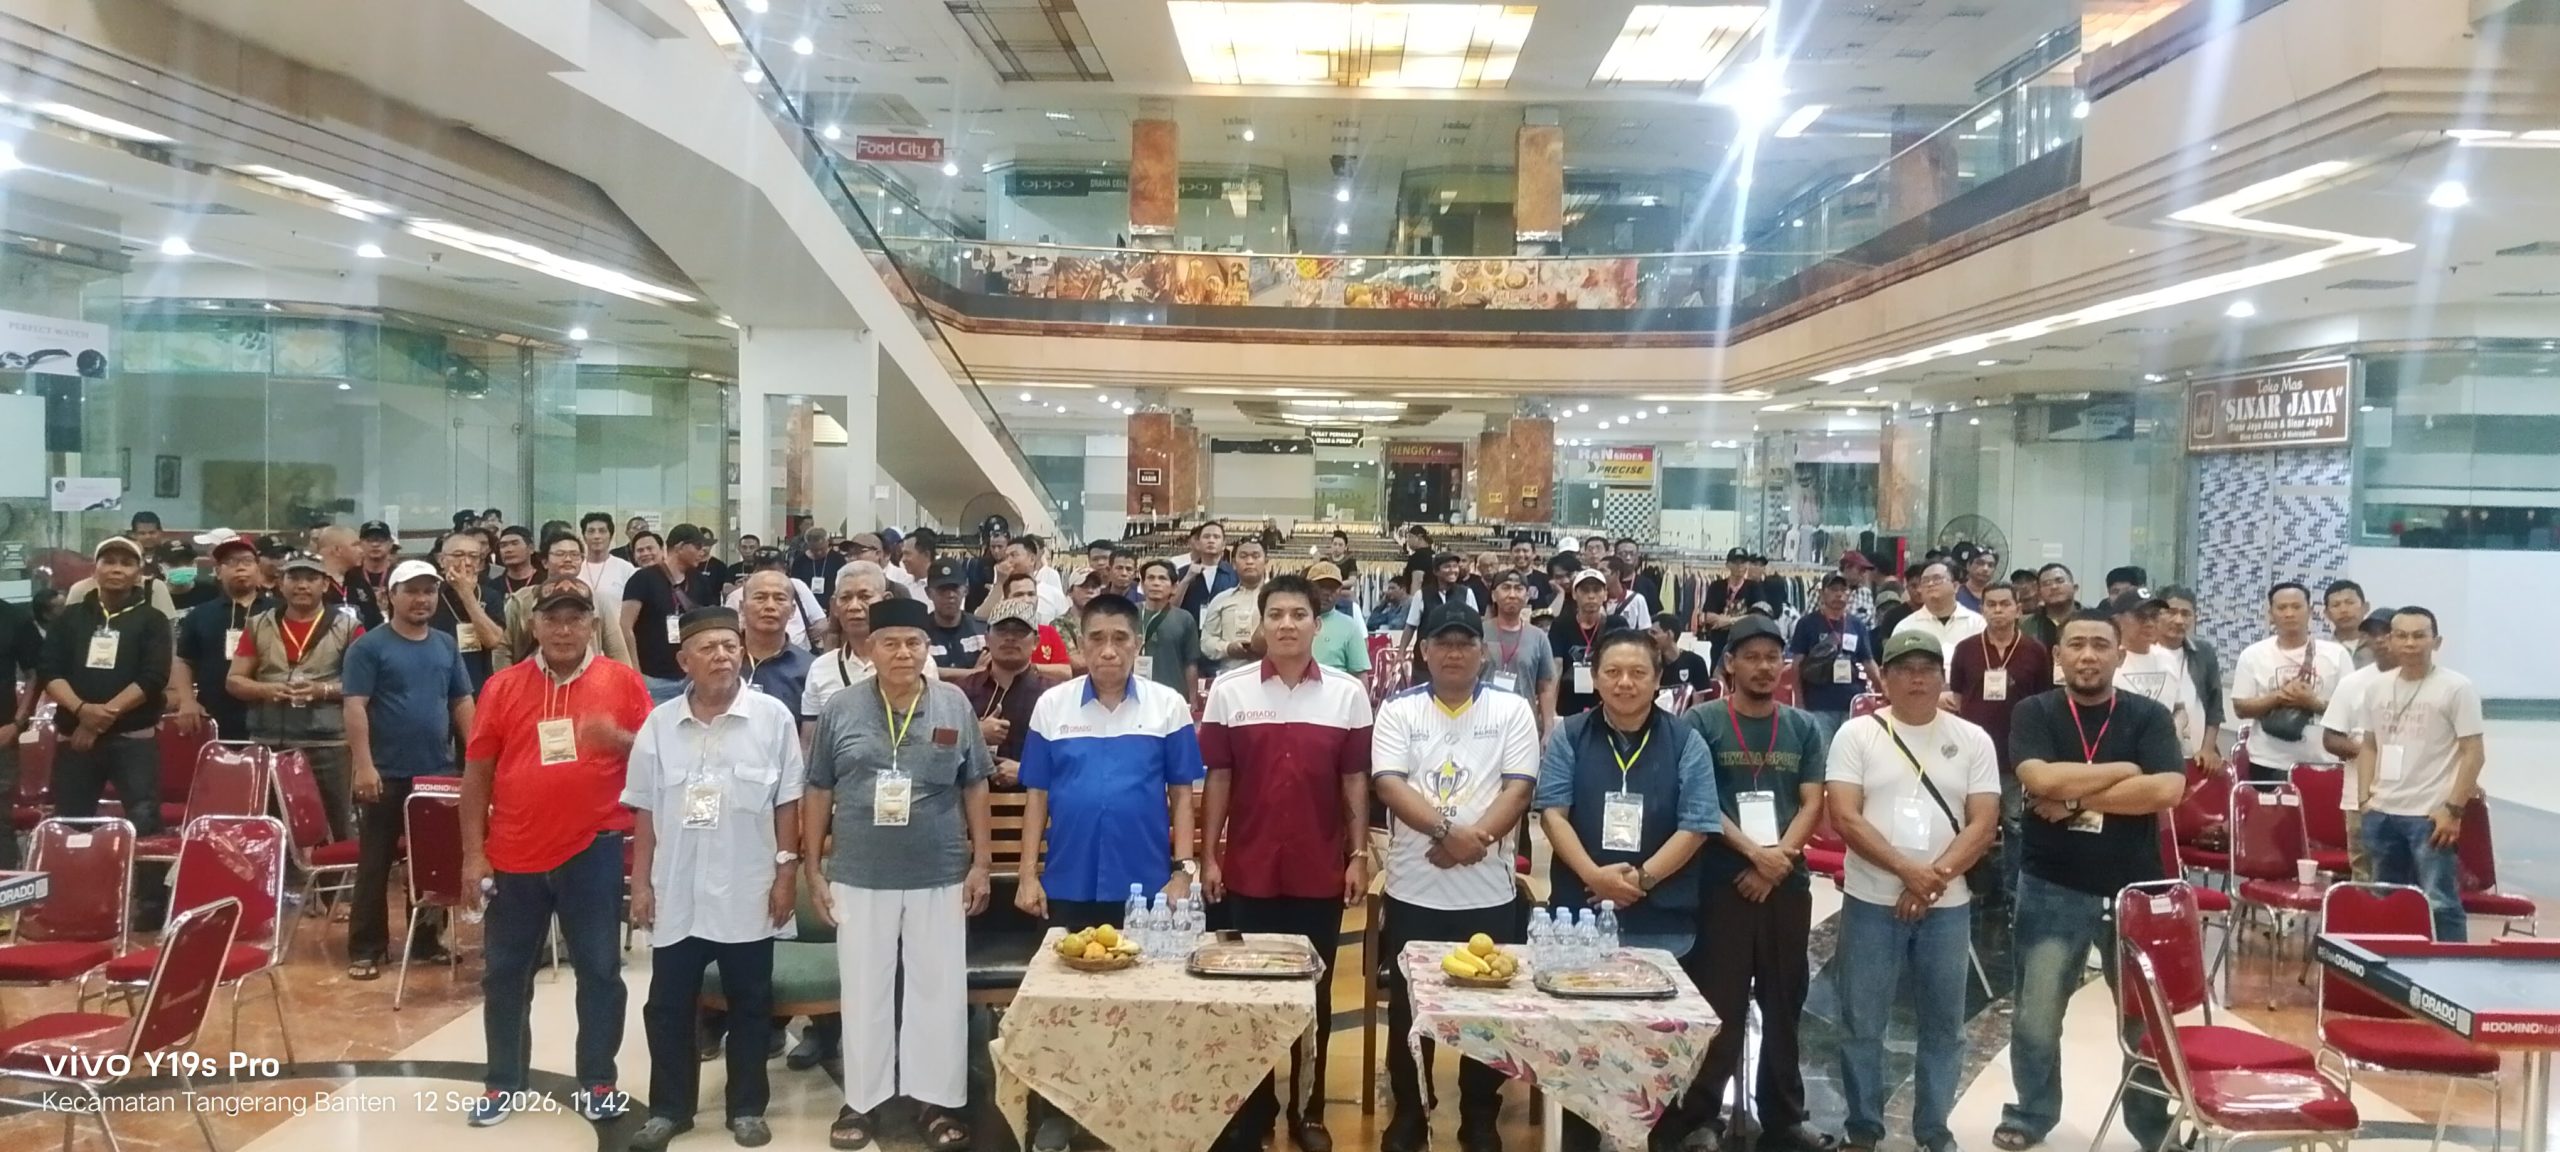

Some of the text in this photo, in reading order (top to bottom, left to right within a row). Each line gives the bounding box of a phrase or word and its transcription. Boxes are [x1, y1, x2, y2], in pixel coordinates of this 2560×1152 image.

[858, 140, 927, 159] Food City
[9, 322, 89, 339] PERFECT WATCH
[2256, 376, 2303, 394] Toko Mas
[1596, 465, 1645, 474] PRECISE
[1433, 806, 1457, 817] 026
[0, 883, 35, 903] ORADO
[2421, 993, 2457, 1022] ORADO
